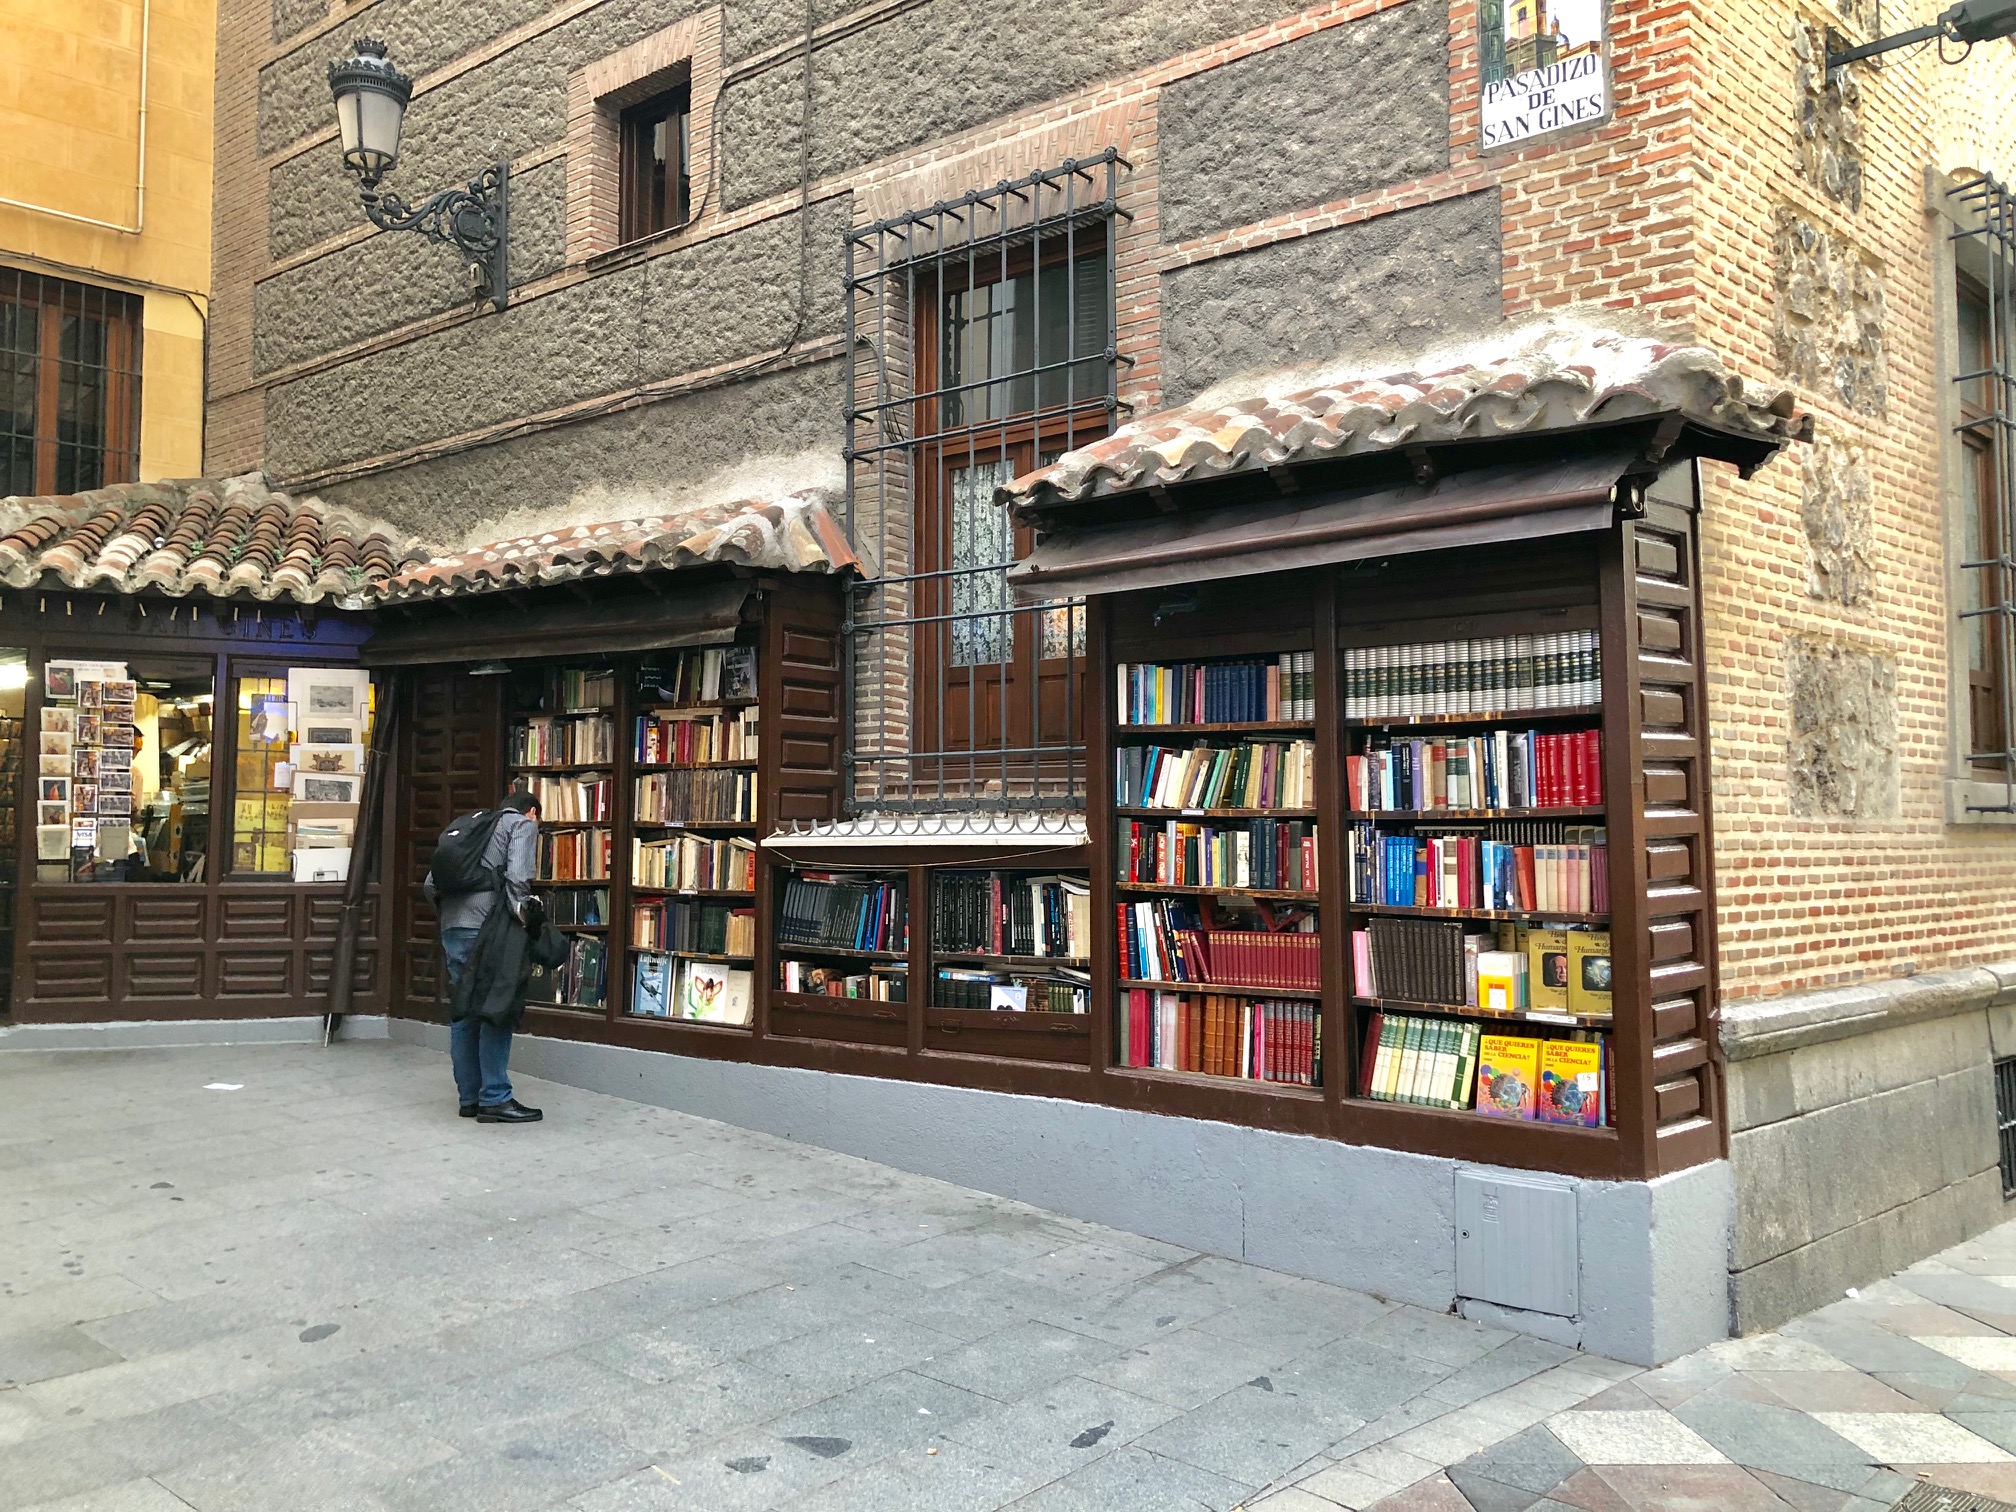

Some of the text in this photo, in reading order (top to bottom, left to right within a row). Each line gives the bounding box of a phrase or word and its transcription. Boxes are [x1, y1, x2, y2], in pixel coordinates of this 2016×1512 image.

[1489, 53, 1596, 104] PASADIZO
[1528, 88, 1556, 110] DE
[1484, 93, 1602, 146] SAN GINES
[640, 954, 668, 965] Luftwaffe
[1504, 1040, 1535, 1049] QUIERES
[1565, 1045, 1596, 1054] QUIERES
[1498, 1052, 1530, 1060] CIENCIA?
[1559, 1058, 1592, 1066] CIENCIA?
